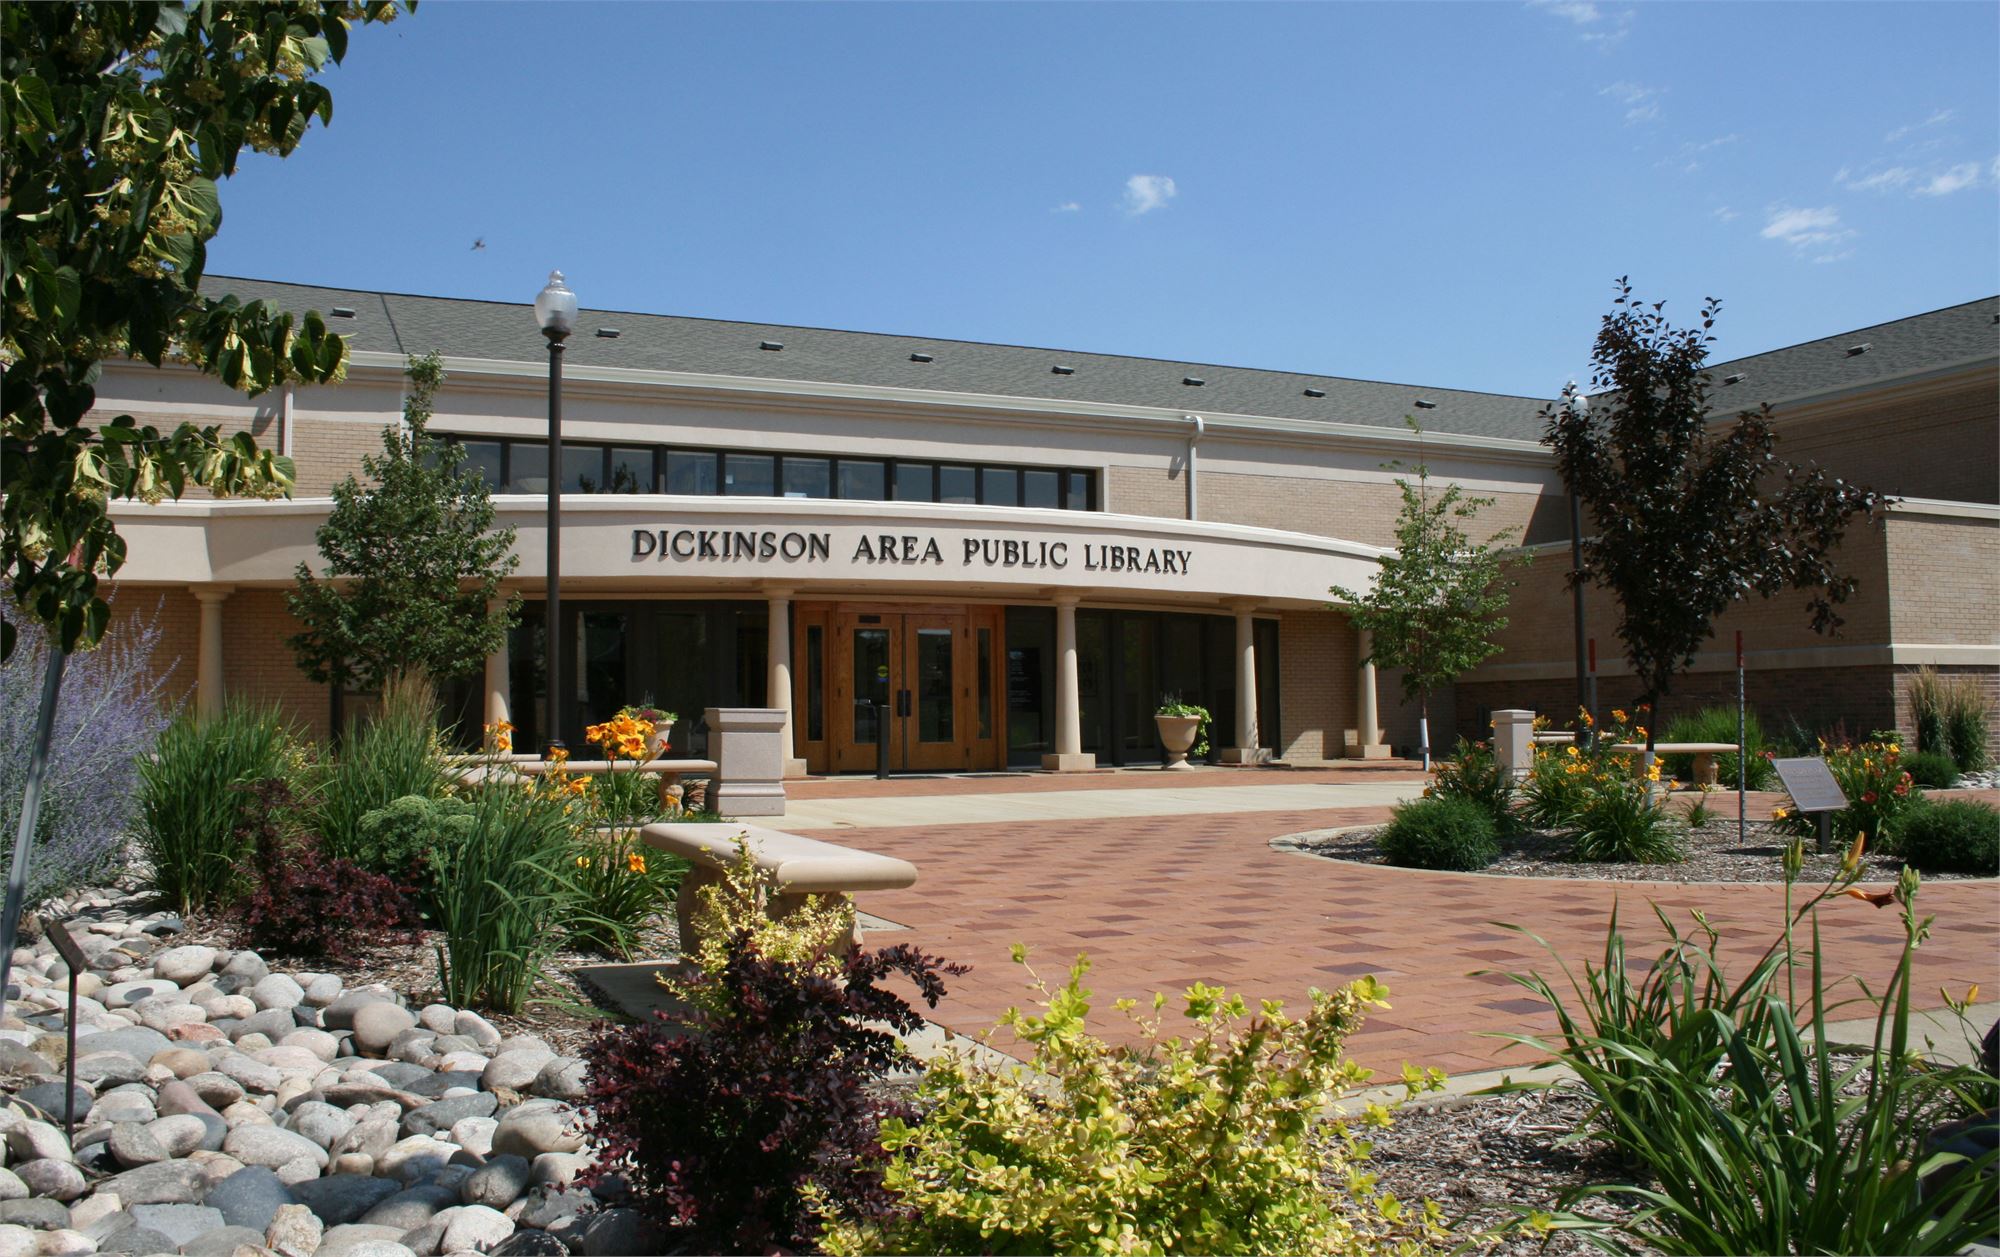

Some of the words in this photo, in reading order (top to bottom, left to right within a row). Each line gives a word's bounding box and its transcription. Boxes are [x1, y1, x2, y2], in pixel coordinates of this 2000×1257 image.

[633, 530, 831, 560] DICKINSON
[853, 535, 943, 562] AREA
[963, 538, 1069, 567] PUBLIC
[1085, 545, 1192, 574] LIBRARY
